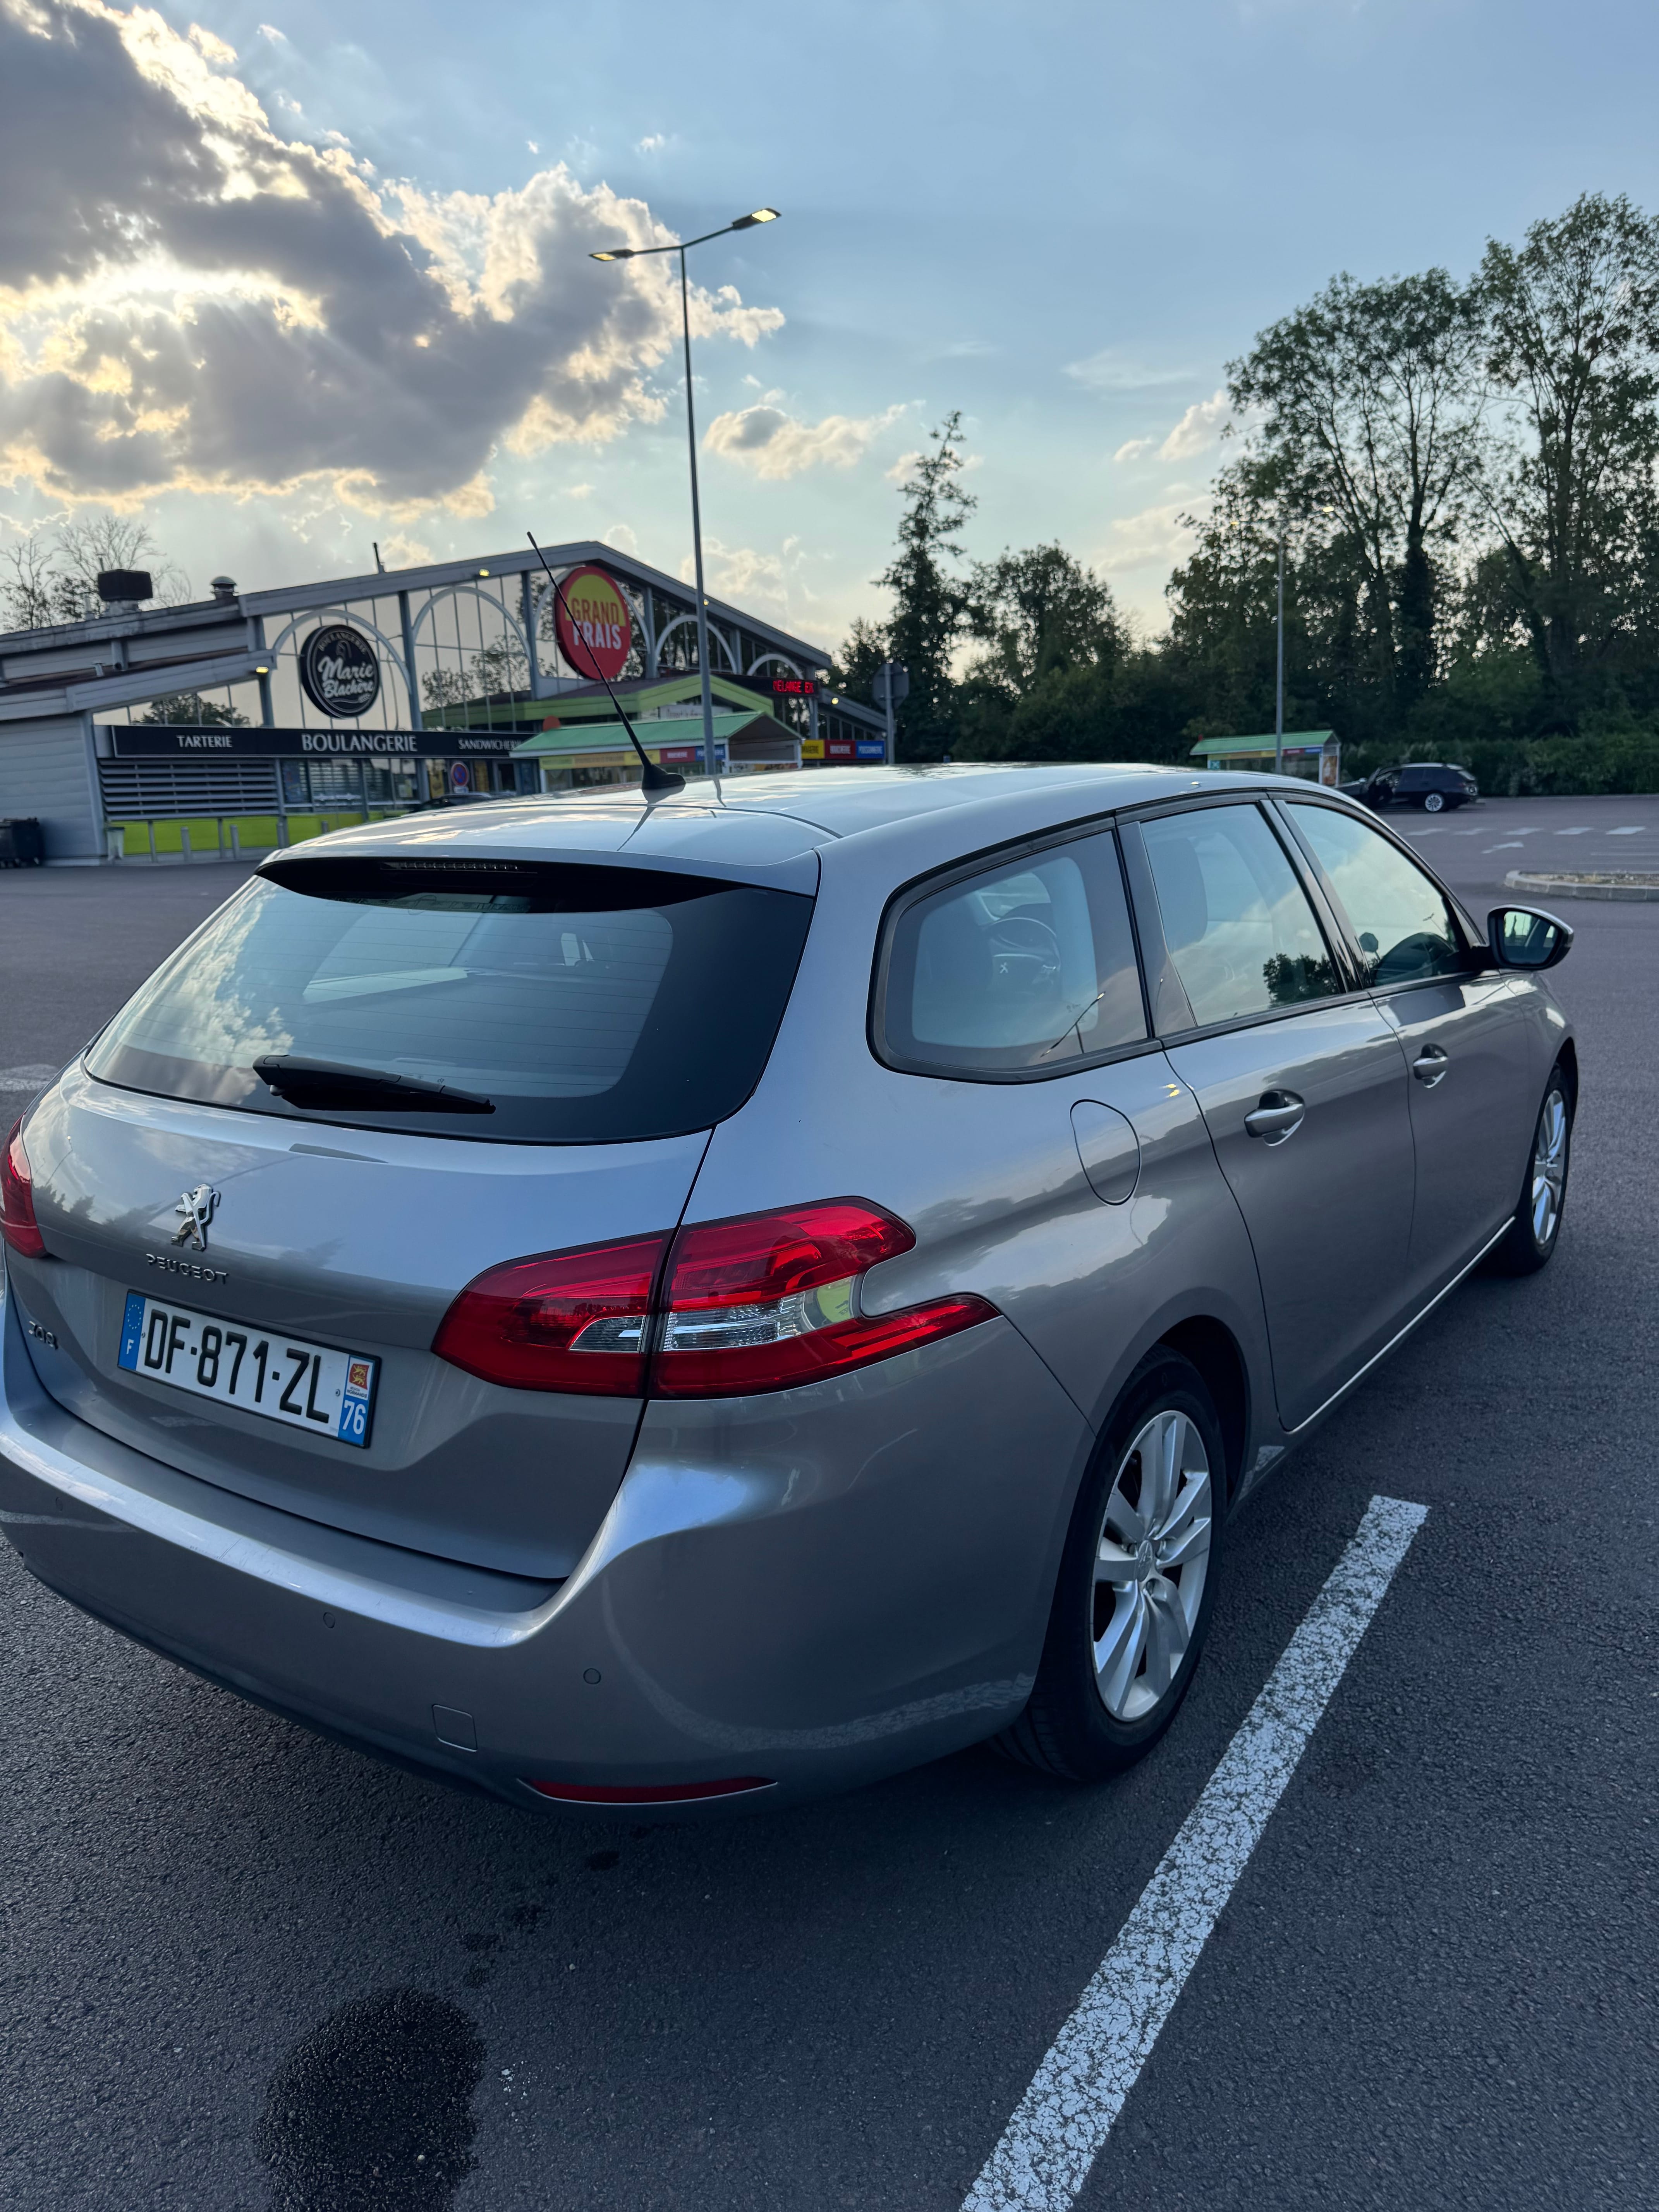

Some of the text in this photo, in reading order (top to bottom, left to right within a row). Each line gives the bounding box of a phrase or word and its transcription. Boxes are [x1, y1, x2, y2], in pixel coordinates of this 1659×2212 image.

[571, 598, 619, 625] GRAND
[572, 620, 622, 649] FRAIS
[318, 656, 373, 681] Marie
[176, 735, 233, 748] TARTERIE
[301, 733, 417, 751] BOULANGERIE
[146, 1253, 228, 1285] PEUGEOT
[28, 1320, 56, 1348] 308
[126, 1338, 134, 1355] F
[144, 1309, 330, 1424] DF-871-ZL
[342, 1400, 366, 1435] 76
